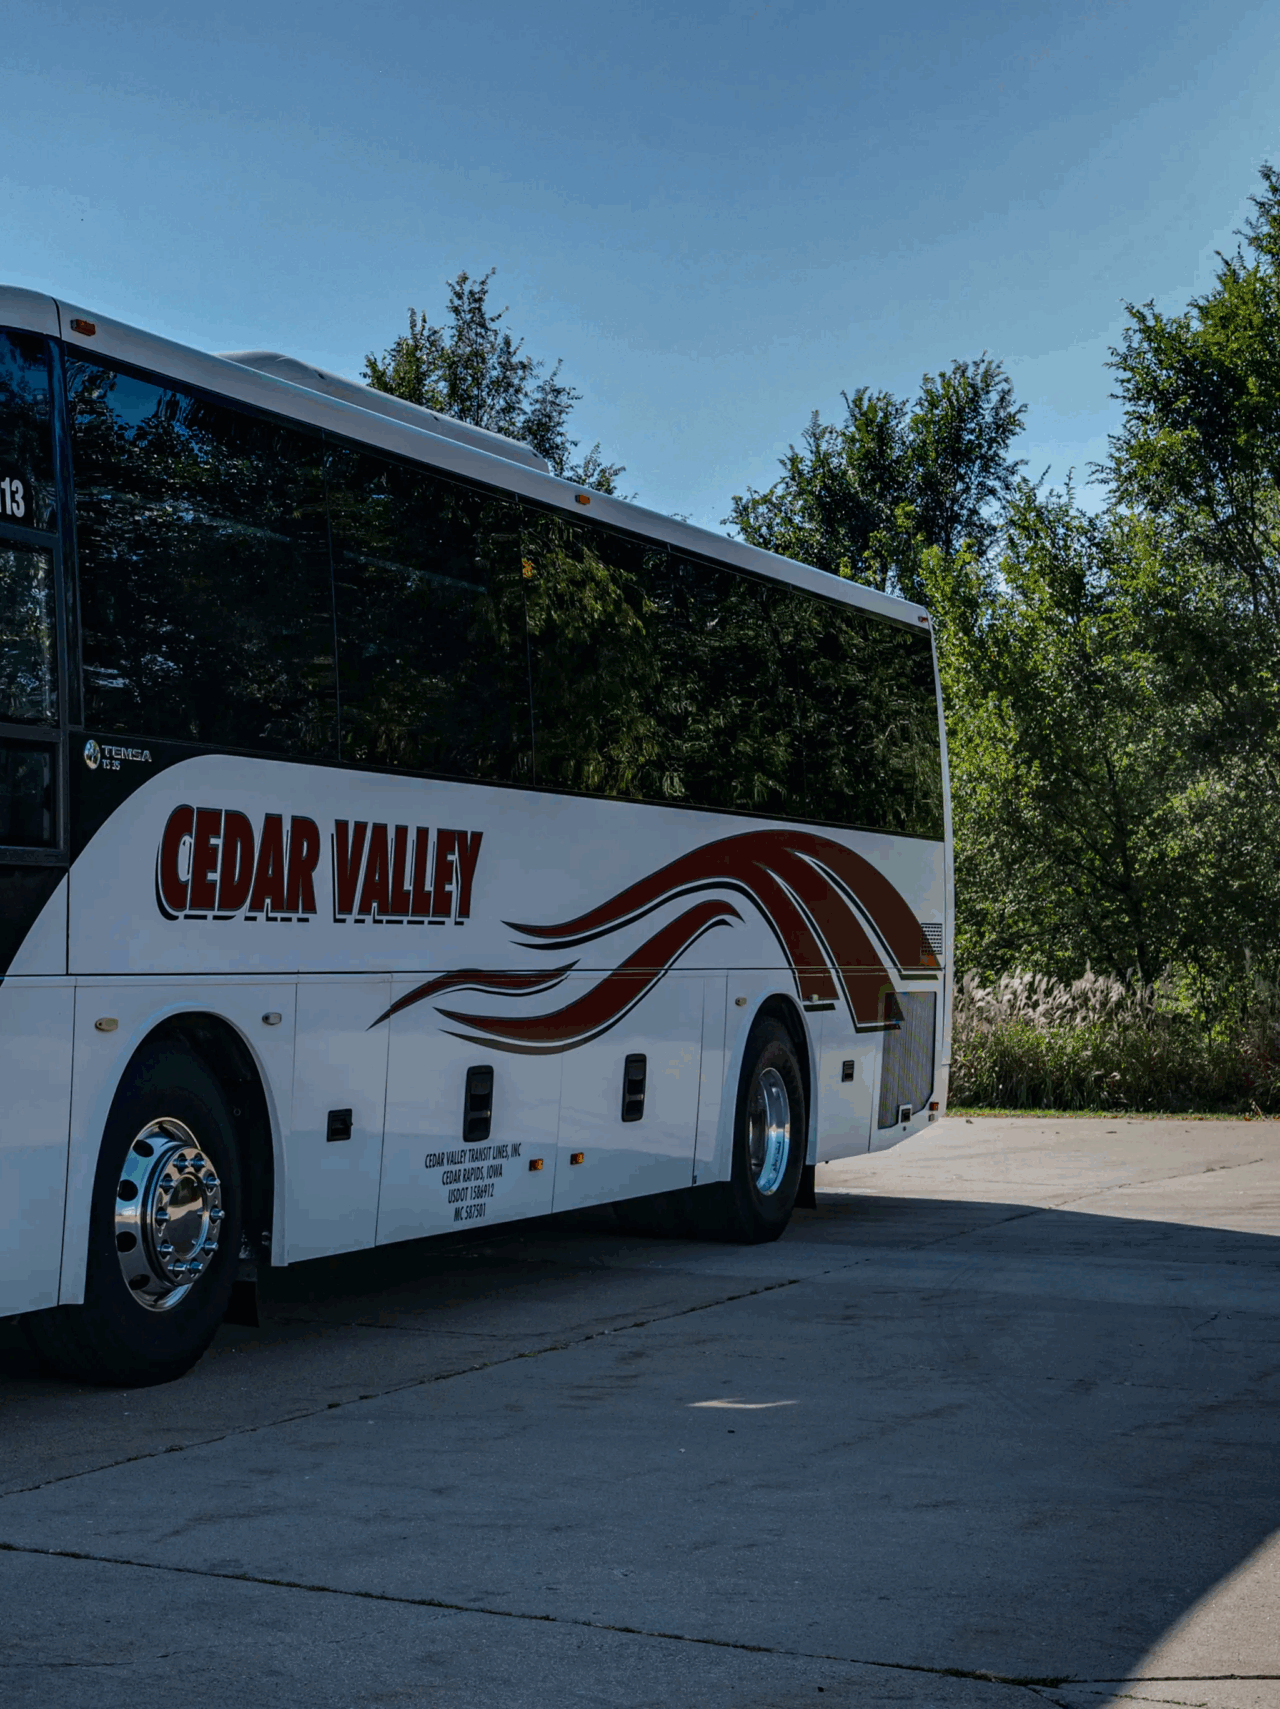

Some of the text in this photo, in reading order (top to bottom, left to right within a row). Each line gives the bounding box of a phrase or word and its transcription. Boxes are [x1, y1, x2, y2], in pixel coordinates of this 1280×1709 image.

[102, 745, 152, 762] TEMSA
[155, 804, 484, 926] CEDAR VALLEY
[425, 1142, 522, 1169] CEDAR VALLEY TRANSIT LINES, INC
[442, 1163, 503, 1186] CEDAR RAPIDS, IOWA
[448, 1183, 495, 1204] USDOT 1586912
[454, 1202, 486, 1222] MC 587501
